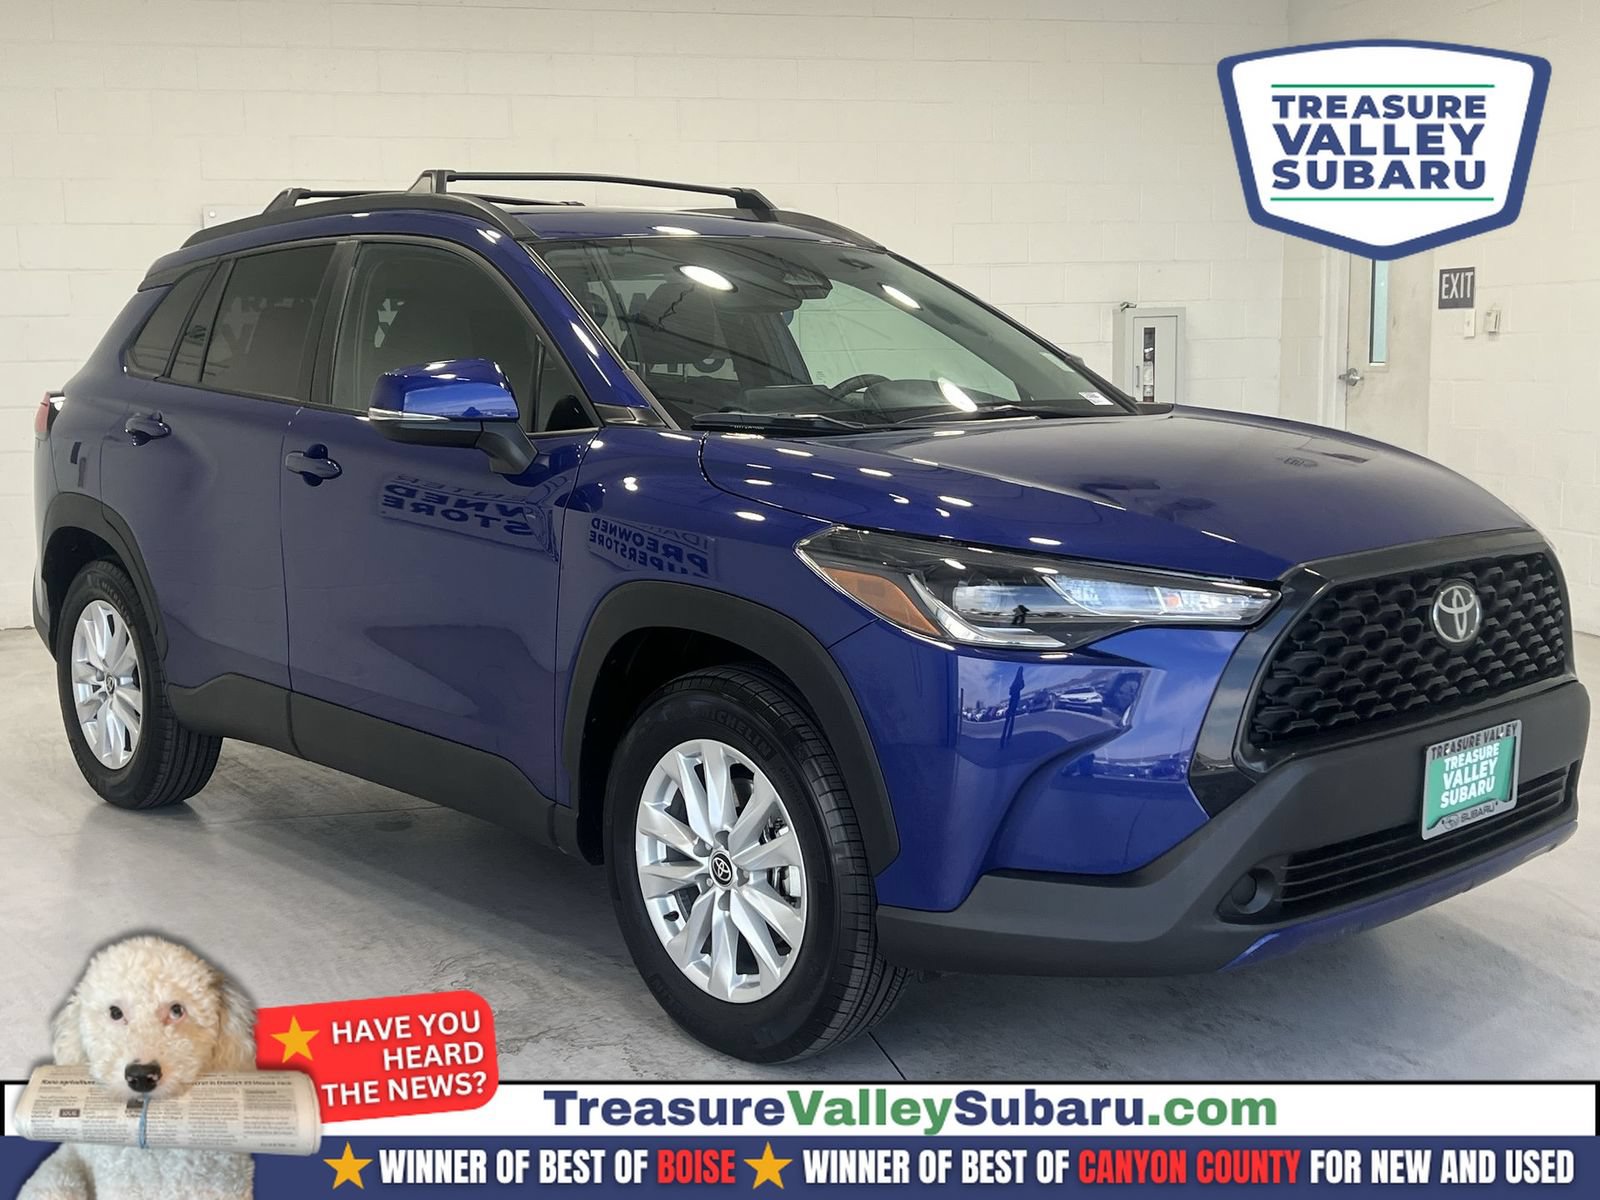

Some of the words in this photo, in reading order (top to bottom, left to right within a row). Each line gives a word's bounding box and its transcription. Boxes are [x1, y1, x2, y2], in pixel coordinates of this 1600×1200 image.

[1441, 271, 1475, 300] EXIT
[1431, 733, 1481, 760] TREASURE
[1443, 742, 1500, 772] TREASURE
[1442, 757, 1498, 791] VALLEY
[1440, 775, 1496, 809] SUBARU
[1460, 803, 1495, 823] SUBARU
